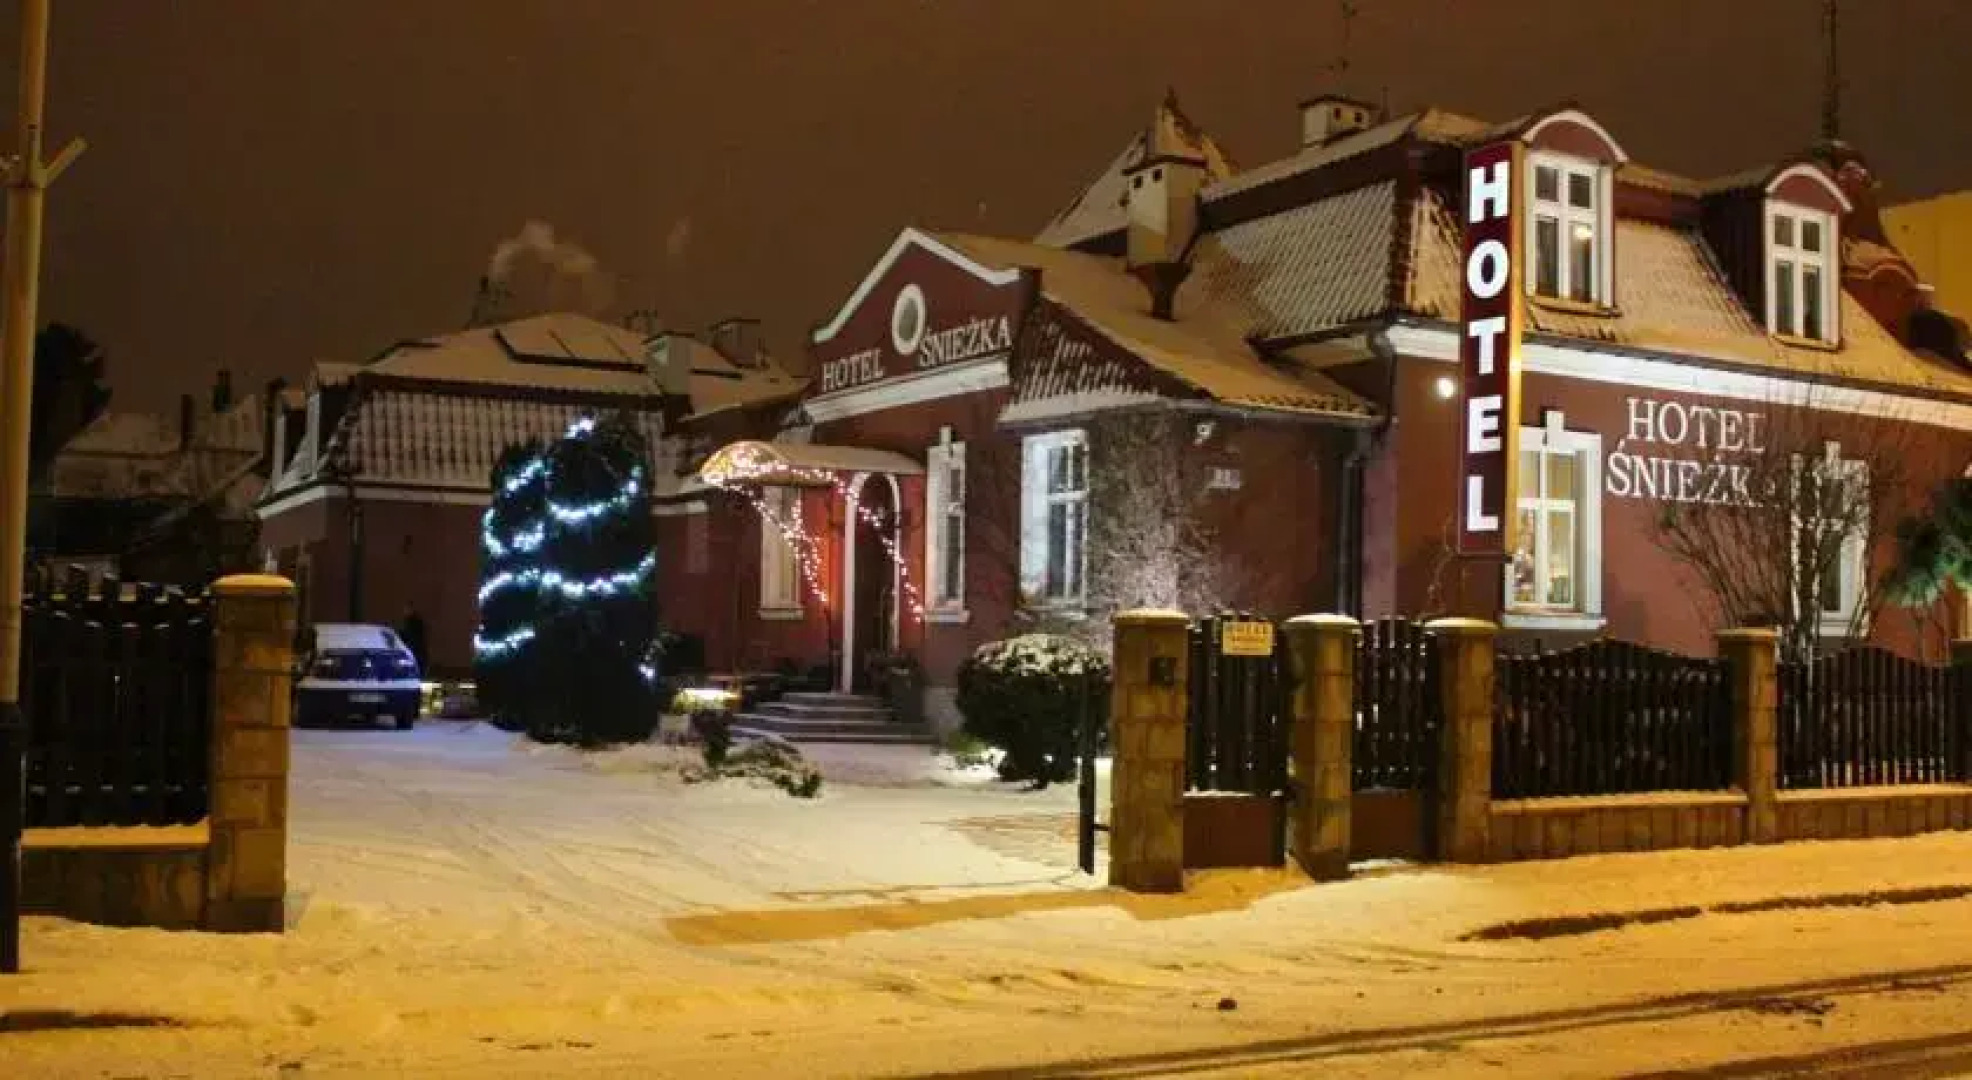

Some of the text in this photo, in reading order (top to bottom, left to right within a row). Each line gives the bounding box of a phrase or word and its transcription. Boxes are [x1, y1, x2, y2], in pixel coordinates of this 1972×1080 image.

[822, 315, 1012, 392] HOTEL ŚNIEŻKA
[1467, 161, 1510, 532] HOTEL
[1626, 396, 1767, 453] HOTEL
